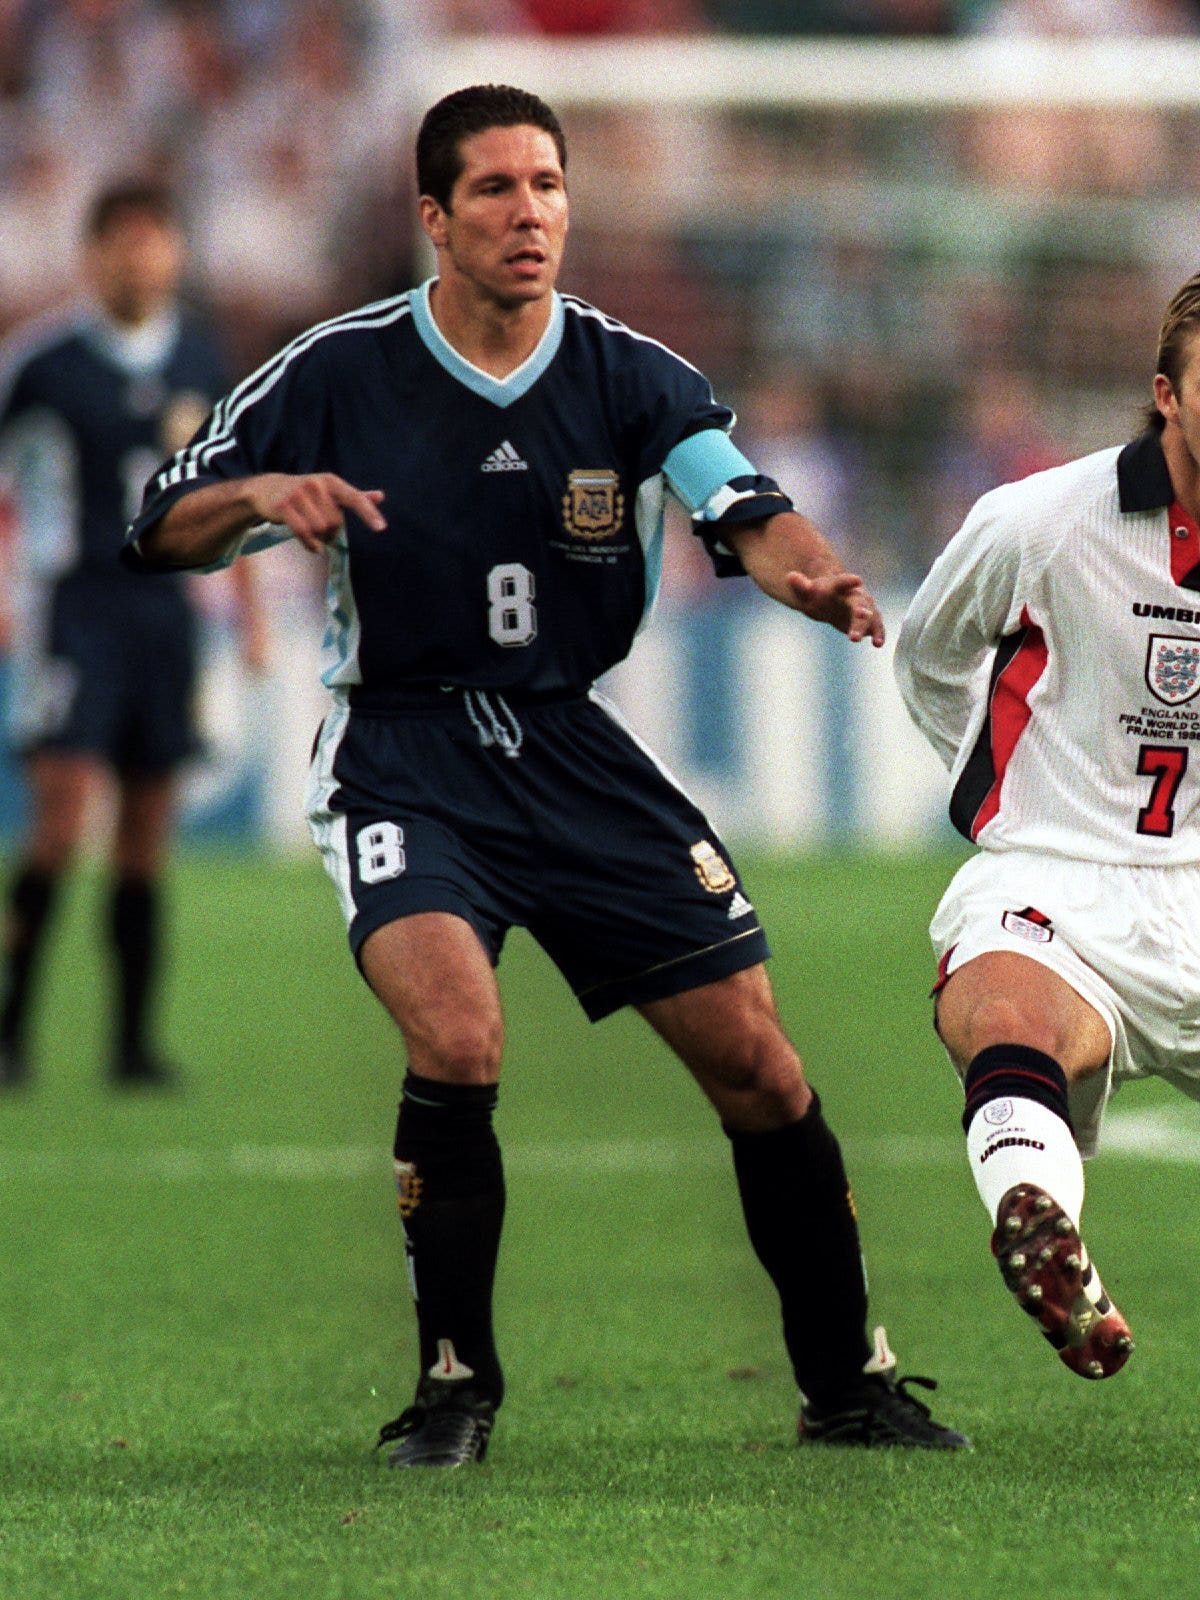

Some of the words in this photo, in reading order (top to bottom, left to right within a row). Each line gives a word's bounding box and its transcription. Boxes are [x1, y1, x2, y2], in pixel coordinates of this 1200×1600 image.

[481, 460, 528, 472] adidas
[487, 562, 538, 648] 8
[1119, 713, 1143, 726] FIFA
[1146, 718, 1188, 731] WORLD
[1141, 707, 1199, 721] ENGLAND
[1126, 725, 1174, 739] FRANCE
[1136, 744, 1189, 838] 7
[356, 821, 406, 885] 8
[980, 1137, 1045, 1163] UMBRO
